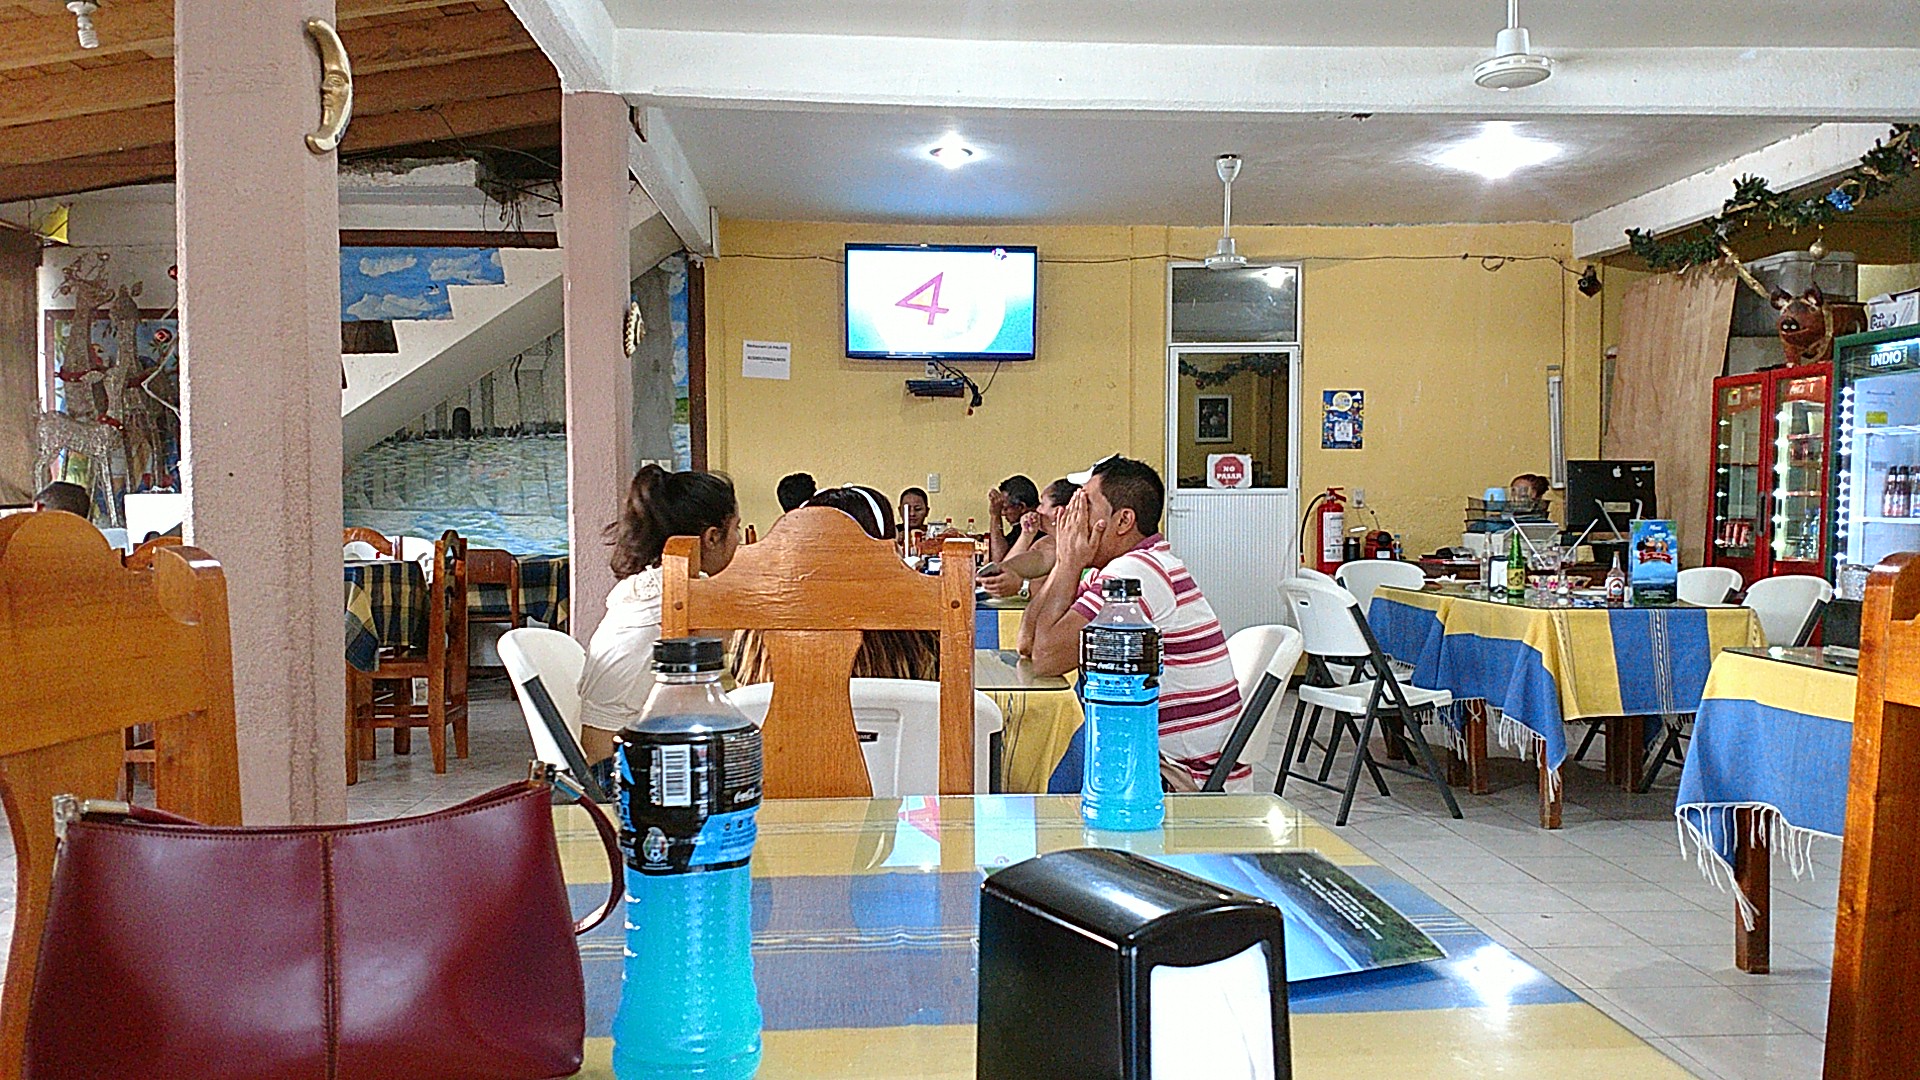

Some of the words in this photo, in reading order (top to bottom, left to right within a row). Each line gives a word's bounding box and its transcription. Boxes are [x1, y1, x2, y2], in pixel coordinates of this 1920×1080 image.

[895, 271, 949, 325] 4
[1870, 349, 1902, 367] INDIO
[1216, 472, 1243, 480] PASAR
